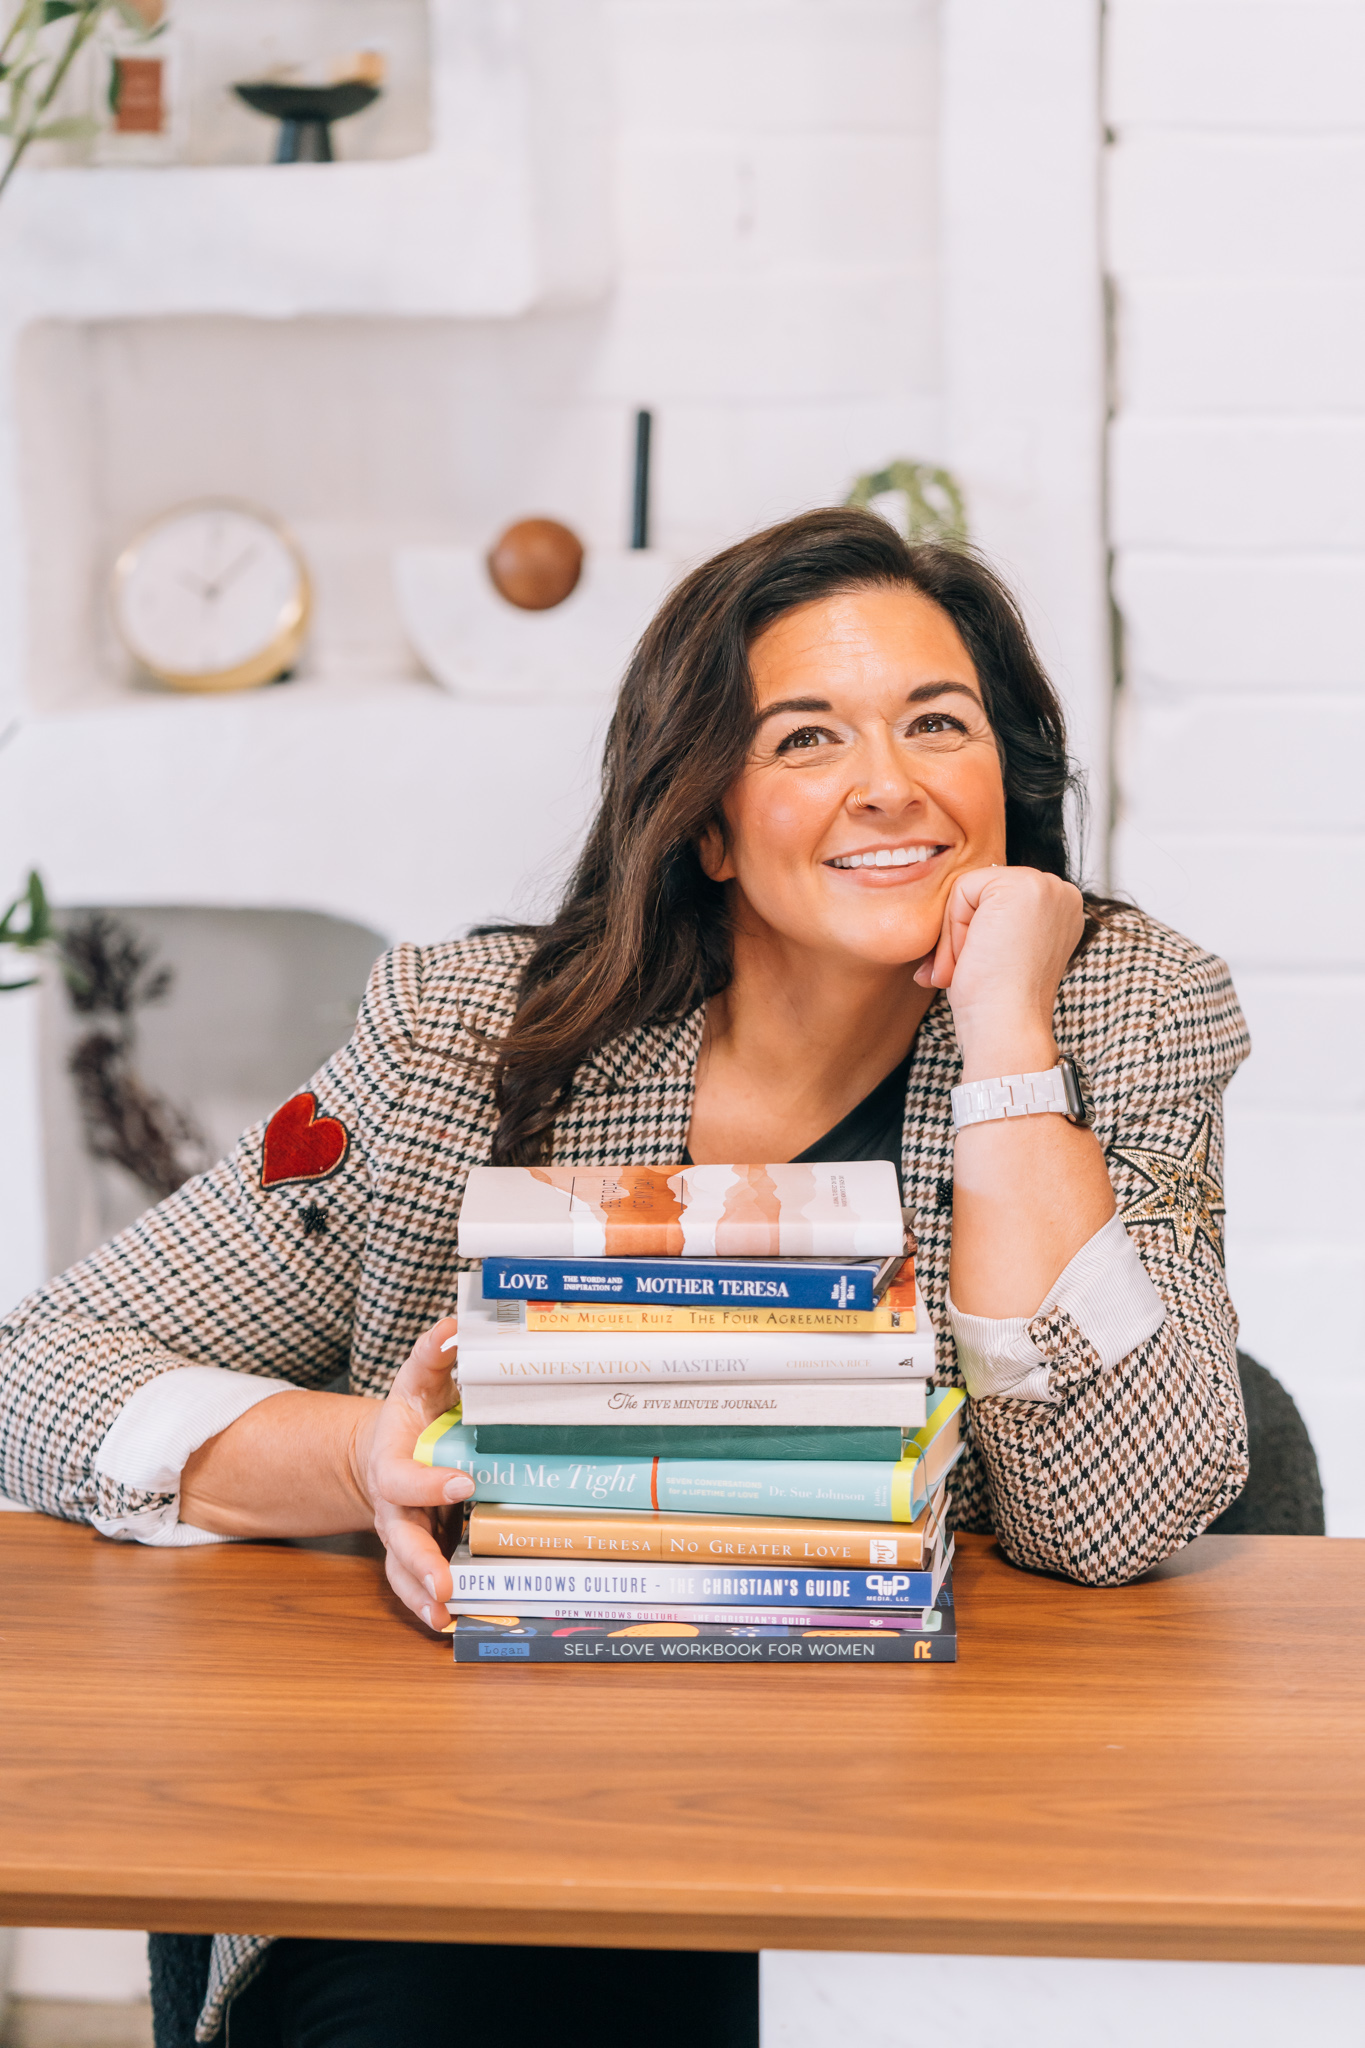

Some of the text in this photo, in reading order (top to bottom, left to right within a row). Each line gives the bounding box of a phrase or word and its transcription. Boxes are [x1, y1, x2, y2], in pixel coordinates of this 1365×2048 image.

[601, 1179, 623, 1194] PART
[499, 1273, 548, 1290] LOVE
[563, 1275, 579, 1283] THE
[580, 1276, 606, 1284] WORDS
[636, 1277, 789, 1298] MOTHER TERESA
[838, 1275, 847, 1308] Mountain
[846, 1284, 855, 1299] Arts
[539, 1312, 673, 1324] DON MIGUEL RUIZ
[689, 1311, 858, 1325] THE FOUR AGREEMENTS
[499, 1358, 750, 1376] MANIFESTATION MASTERY
[786, 1359, 872, 1369] CHRISTINA RICE
[607, 1392, 777, 1410] The FIVE MINUTE JOURNAL
[523, 1464, 560, 1488] Me
[567, 1464, 638, 1499] Tight
[666, 1477, 763, 1489] SEVEN CONVERSATIONS
[689, 1489, 725, 1497] LIFETIME
[738, 1491, 759, 1499] LOVE
[769, 1485, 865, 1501] Dr. Sue Johnson
[498, 1533, 651, 1551] MOTHER TERESA
[670, 1538, 851, 1558] NO GREATER LOVE
[459, 1575, 495, 1591] OPEN
[504, 1575, 575, 1593] WINDOWS
[584, 1576, 647, 1593] CULTURE
[669, 1577, 695, 1595] THE
[703, 1578, 799, 1596] CHRISTIAN'S
[805, 1580, 851, 1597] GUIDE
[554, 1609, 579, 1617] OPEN
[585, 1610, 632, 1619] WINDOWS
[637, 1612, 678, 1621] CULTURE
[693, 1613, 709, 1622] THE
[714, 1615, 777, 1624] CHRISTIAN'S
[782, 1617, 811, 1625] GUIDE
[484, 1645, 524, 1656] Logan
[564, 1643, 875, 1656] SELF-LOVE WORKBOOK FOR WOMEN
